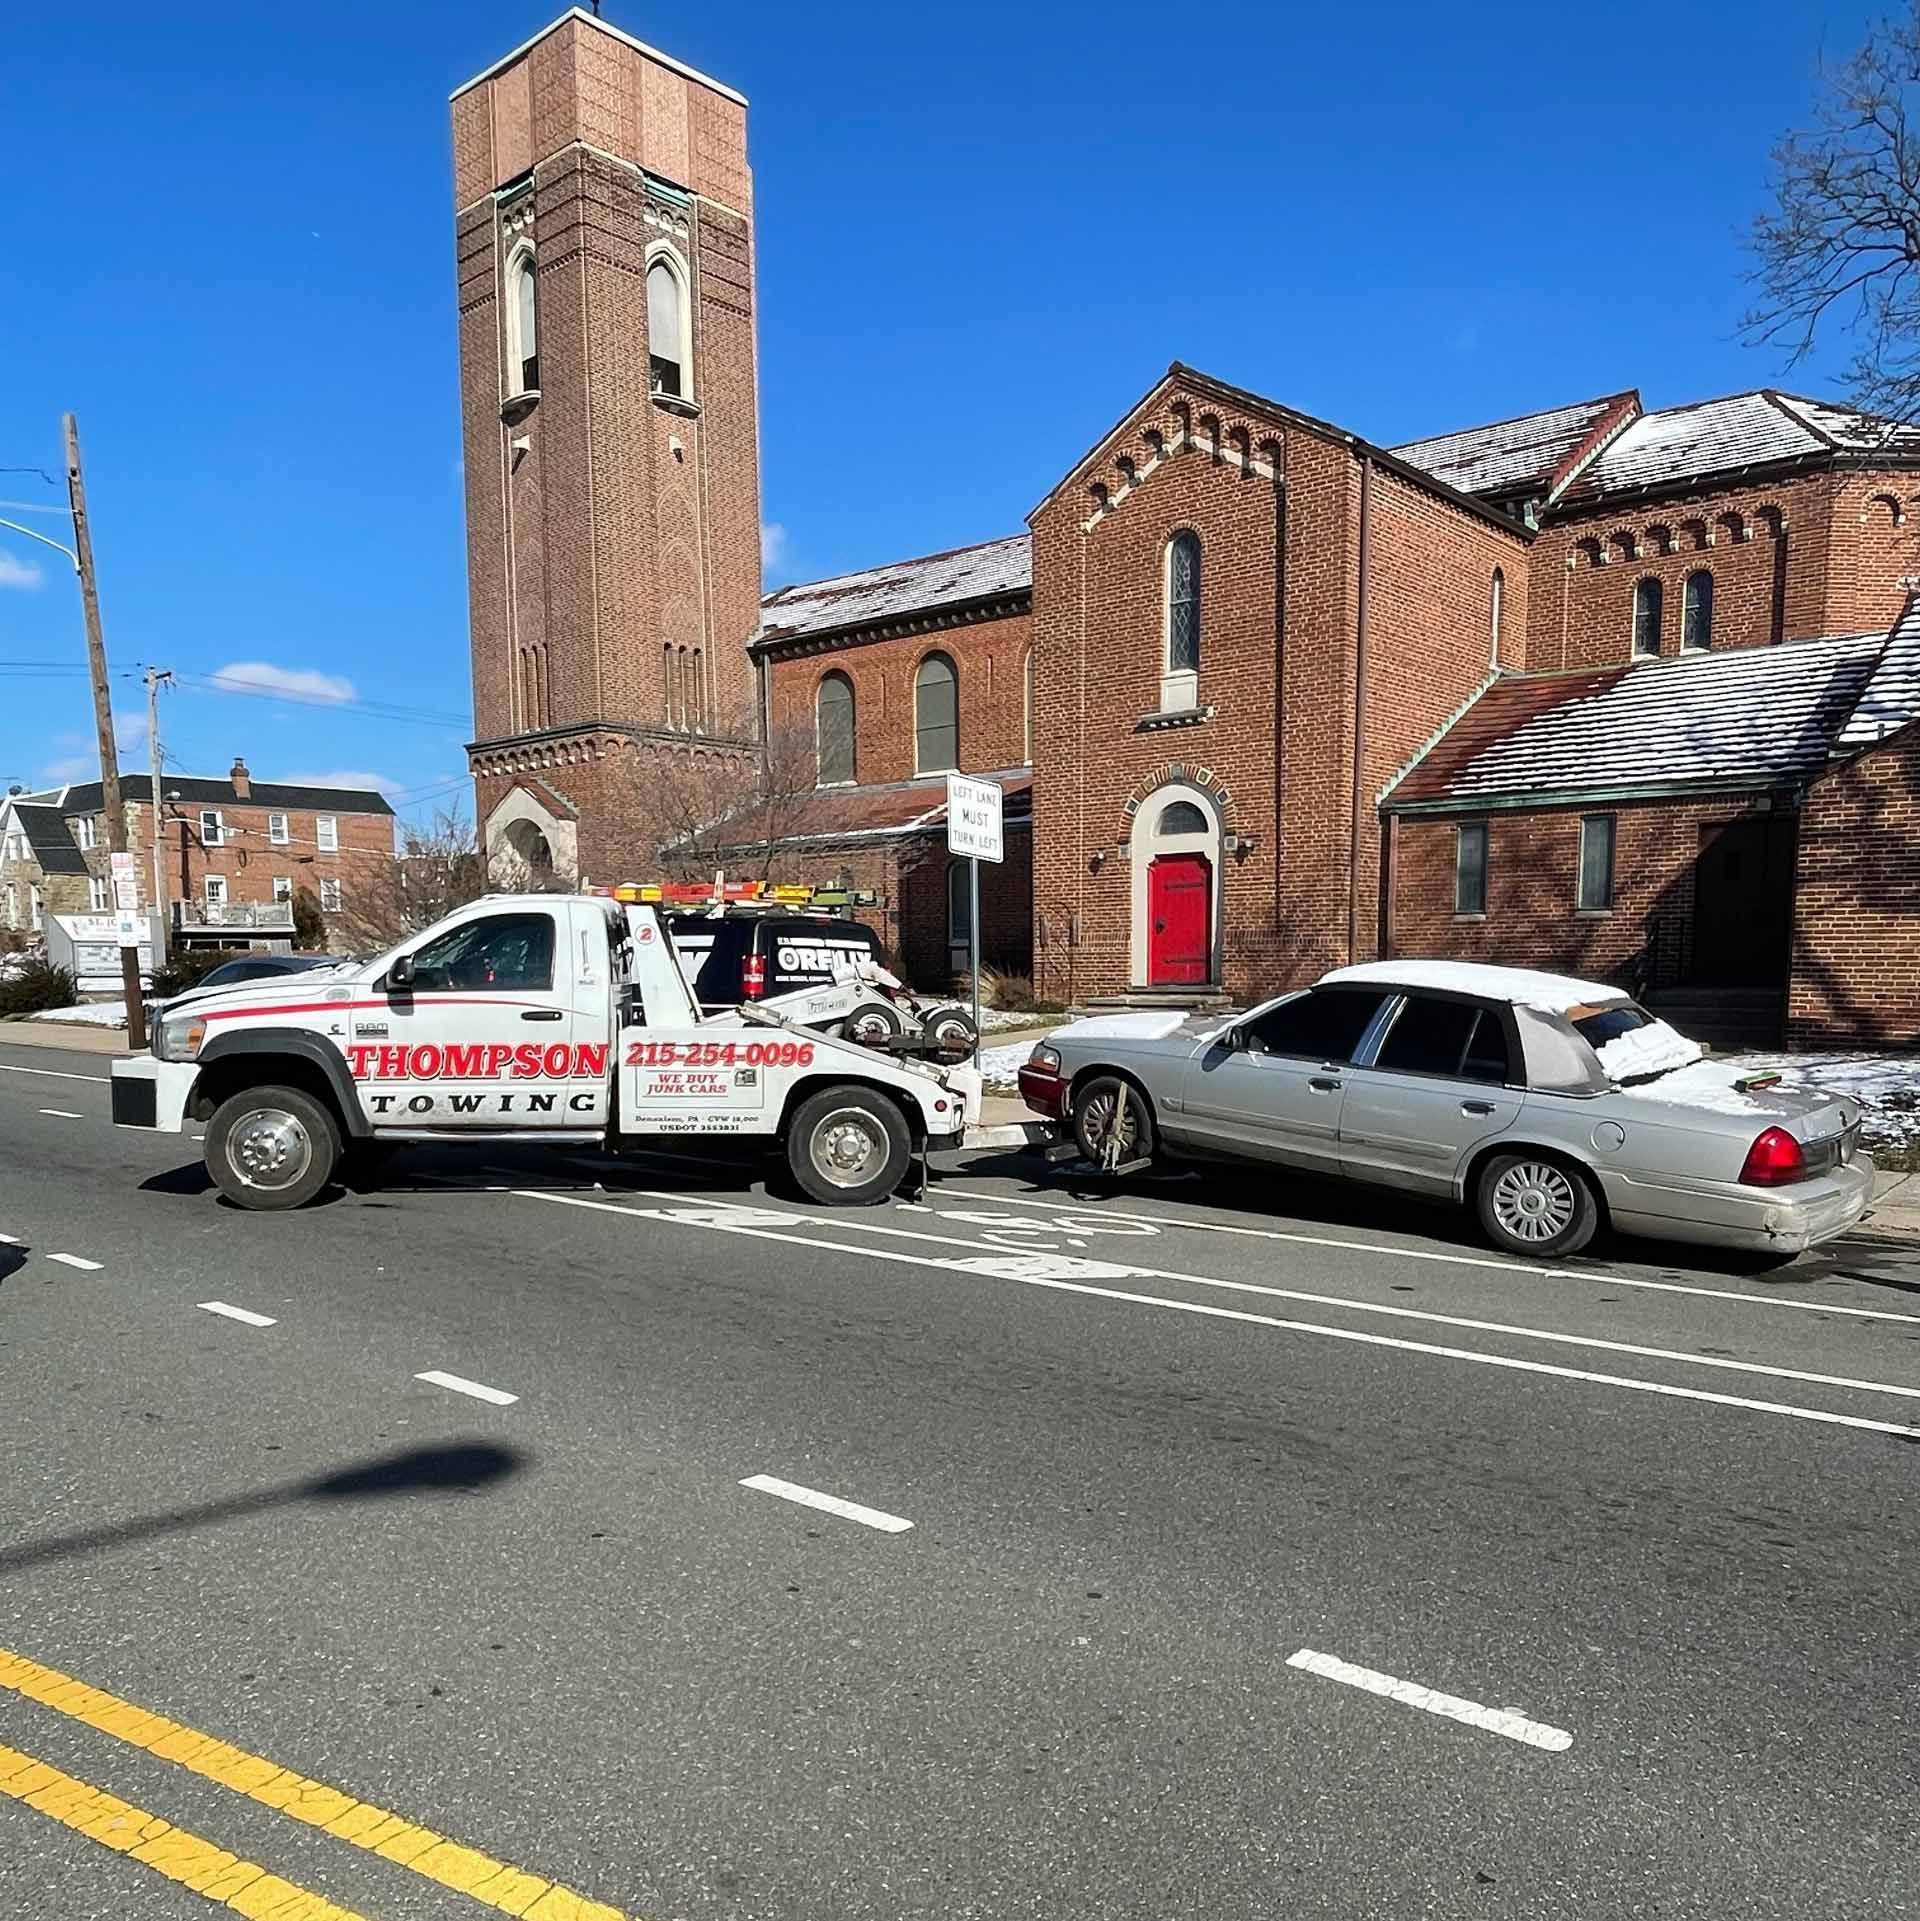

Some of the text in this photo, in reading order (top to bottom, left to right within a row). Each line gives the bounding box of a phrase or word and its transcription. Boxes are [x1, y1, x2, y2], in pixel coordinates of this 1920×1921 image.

[953, 785, 997, 808] LEFT LANE
[962, 808, 989, 828] MUST
[953, 829, 998, 852] TURN LEFT
[641, 927, 652, 941] 2
[349, 1042, 609, 1080] THOMPSON
[625, 1042, 815, 1067] 215-254-0096
[658, 1073, 718, 1084] WE BUY
[647, 1084, 727, 1095] JUNK CARS
[371, 1094, 595, 1113] TOWING
